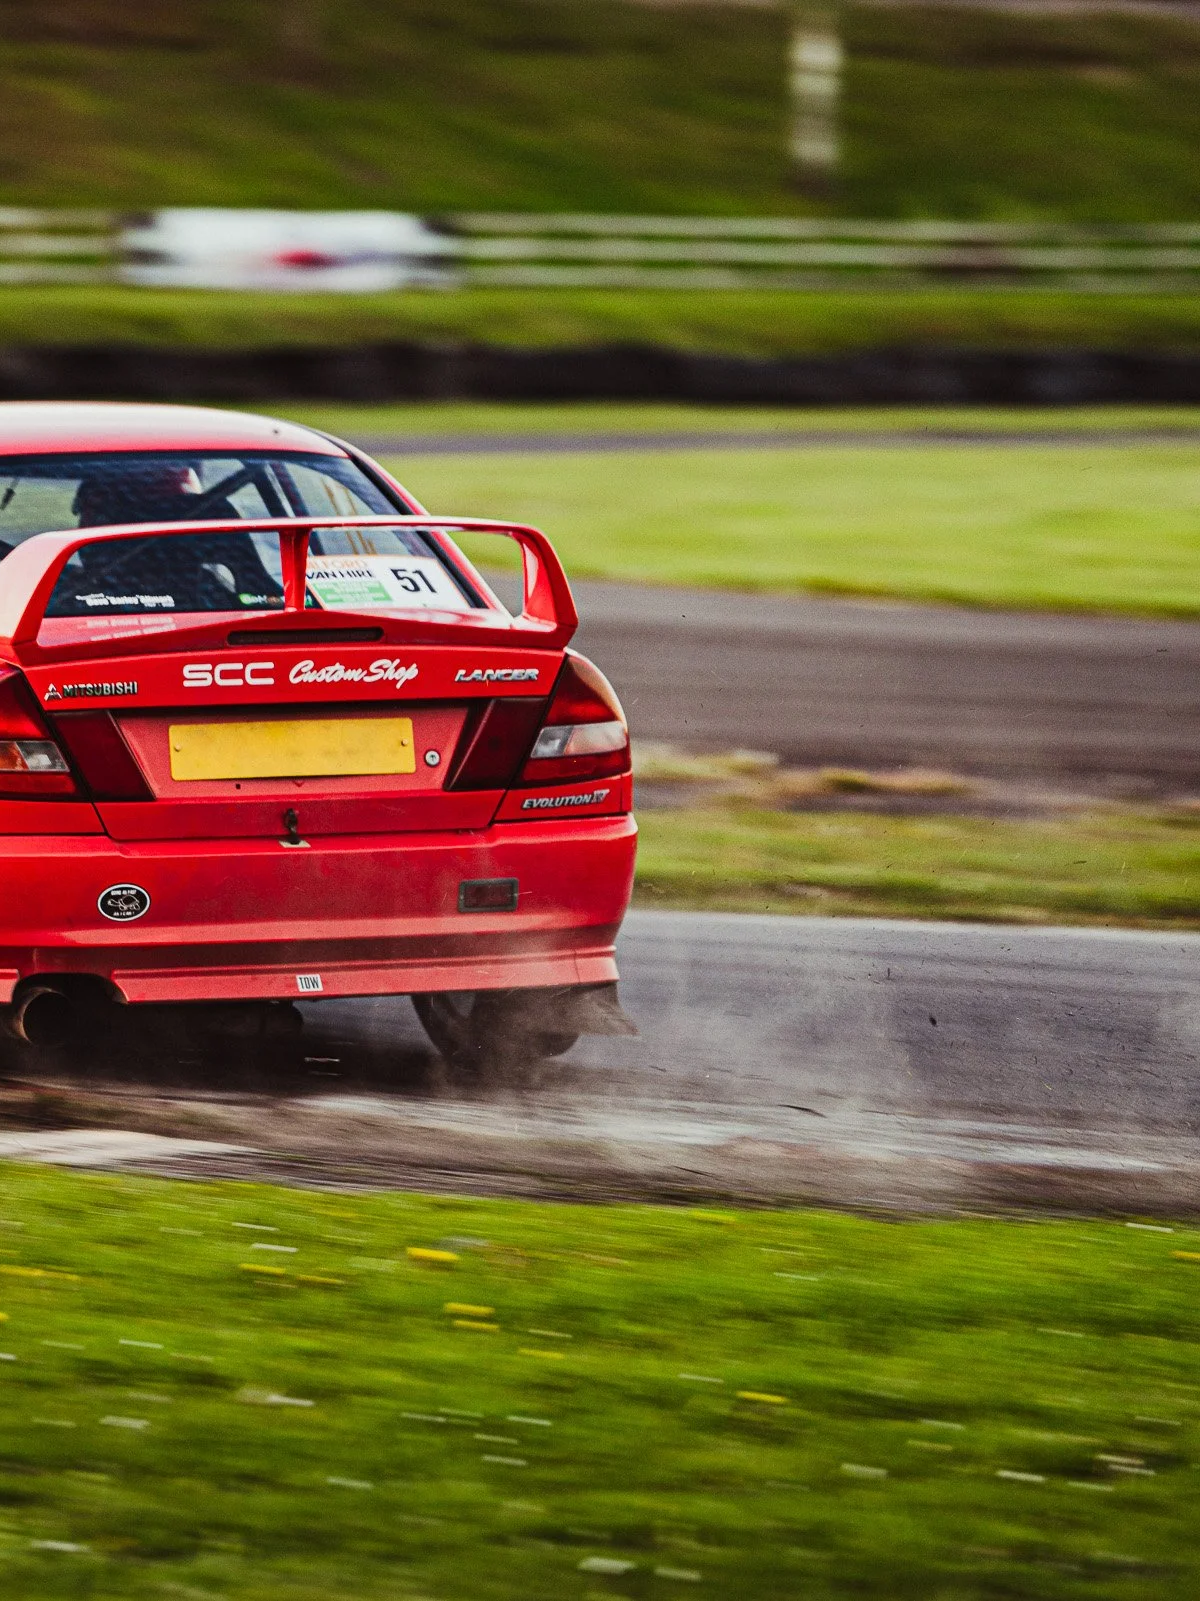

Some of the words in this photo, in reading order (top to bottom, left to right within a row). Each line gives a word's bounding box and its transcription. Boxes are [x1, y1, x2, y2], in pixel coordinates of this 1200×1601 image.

[390, 568, 437, 594] 51
[183, 662, 275, 688] SCC
[288, 659, 367, 684] Custom
[362, 658, 419, 690] Shop
[454, 668, 539, 682] LANCER
[63, 681, 138, 697] MITSUBISHI
[522, 794, 593, 809] EVOLUTION
[298, 976, 320, 990] TOW
